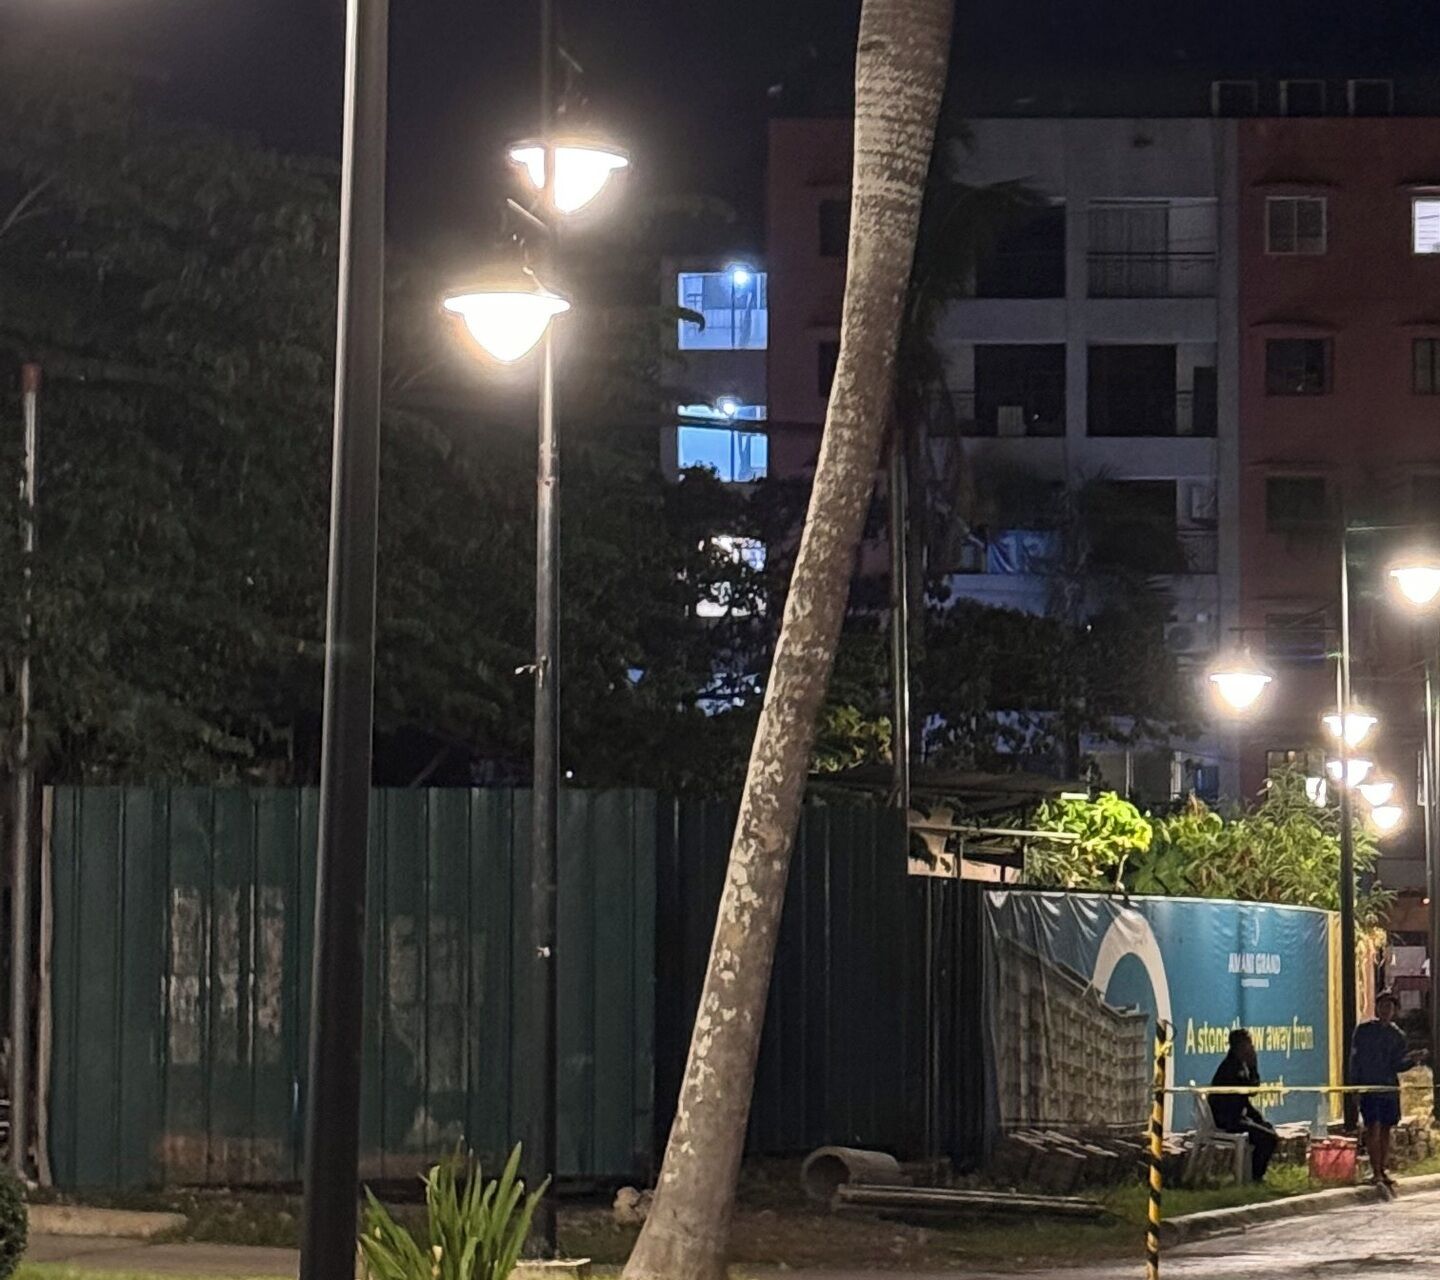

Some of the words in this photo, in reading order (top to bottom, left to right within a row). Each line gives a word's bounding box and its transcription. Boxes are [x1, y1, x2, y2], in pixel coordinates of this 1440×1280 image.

[1184, 1018, 1196, 1056] A
[1198, 1021, 1231, 1055] stone
[1266, 1025, 1291, 1060] away
[1293, 1015, 1314, 1051] from
